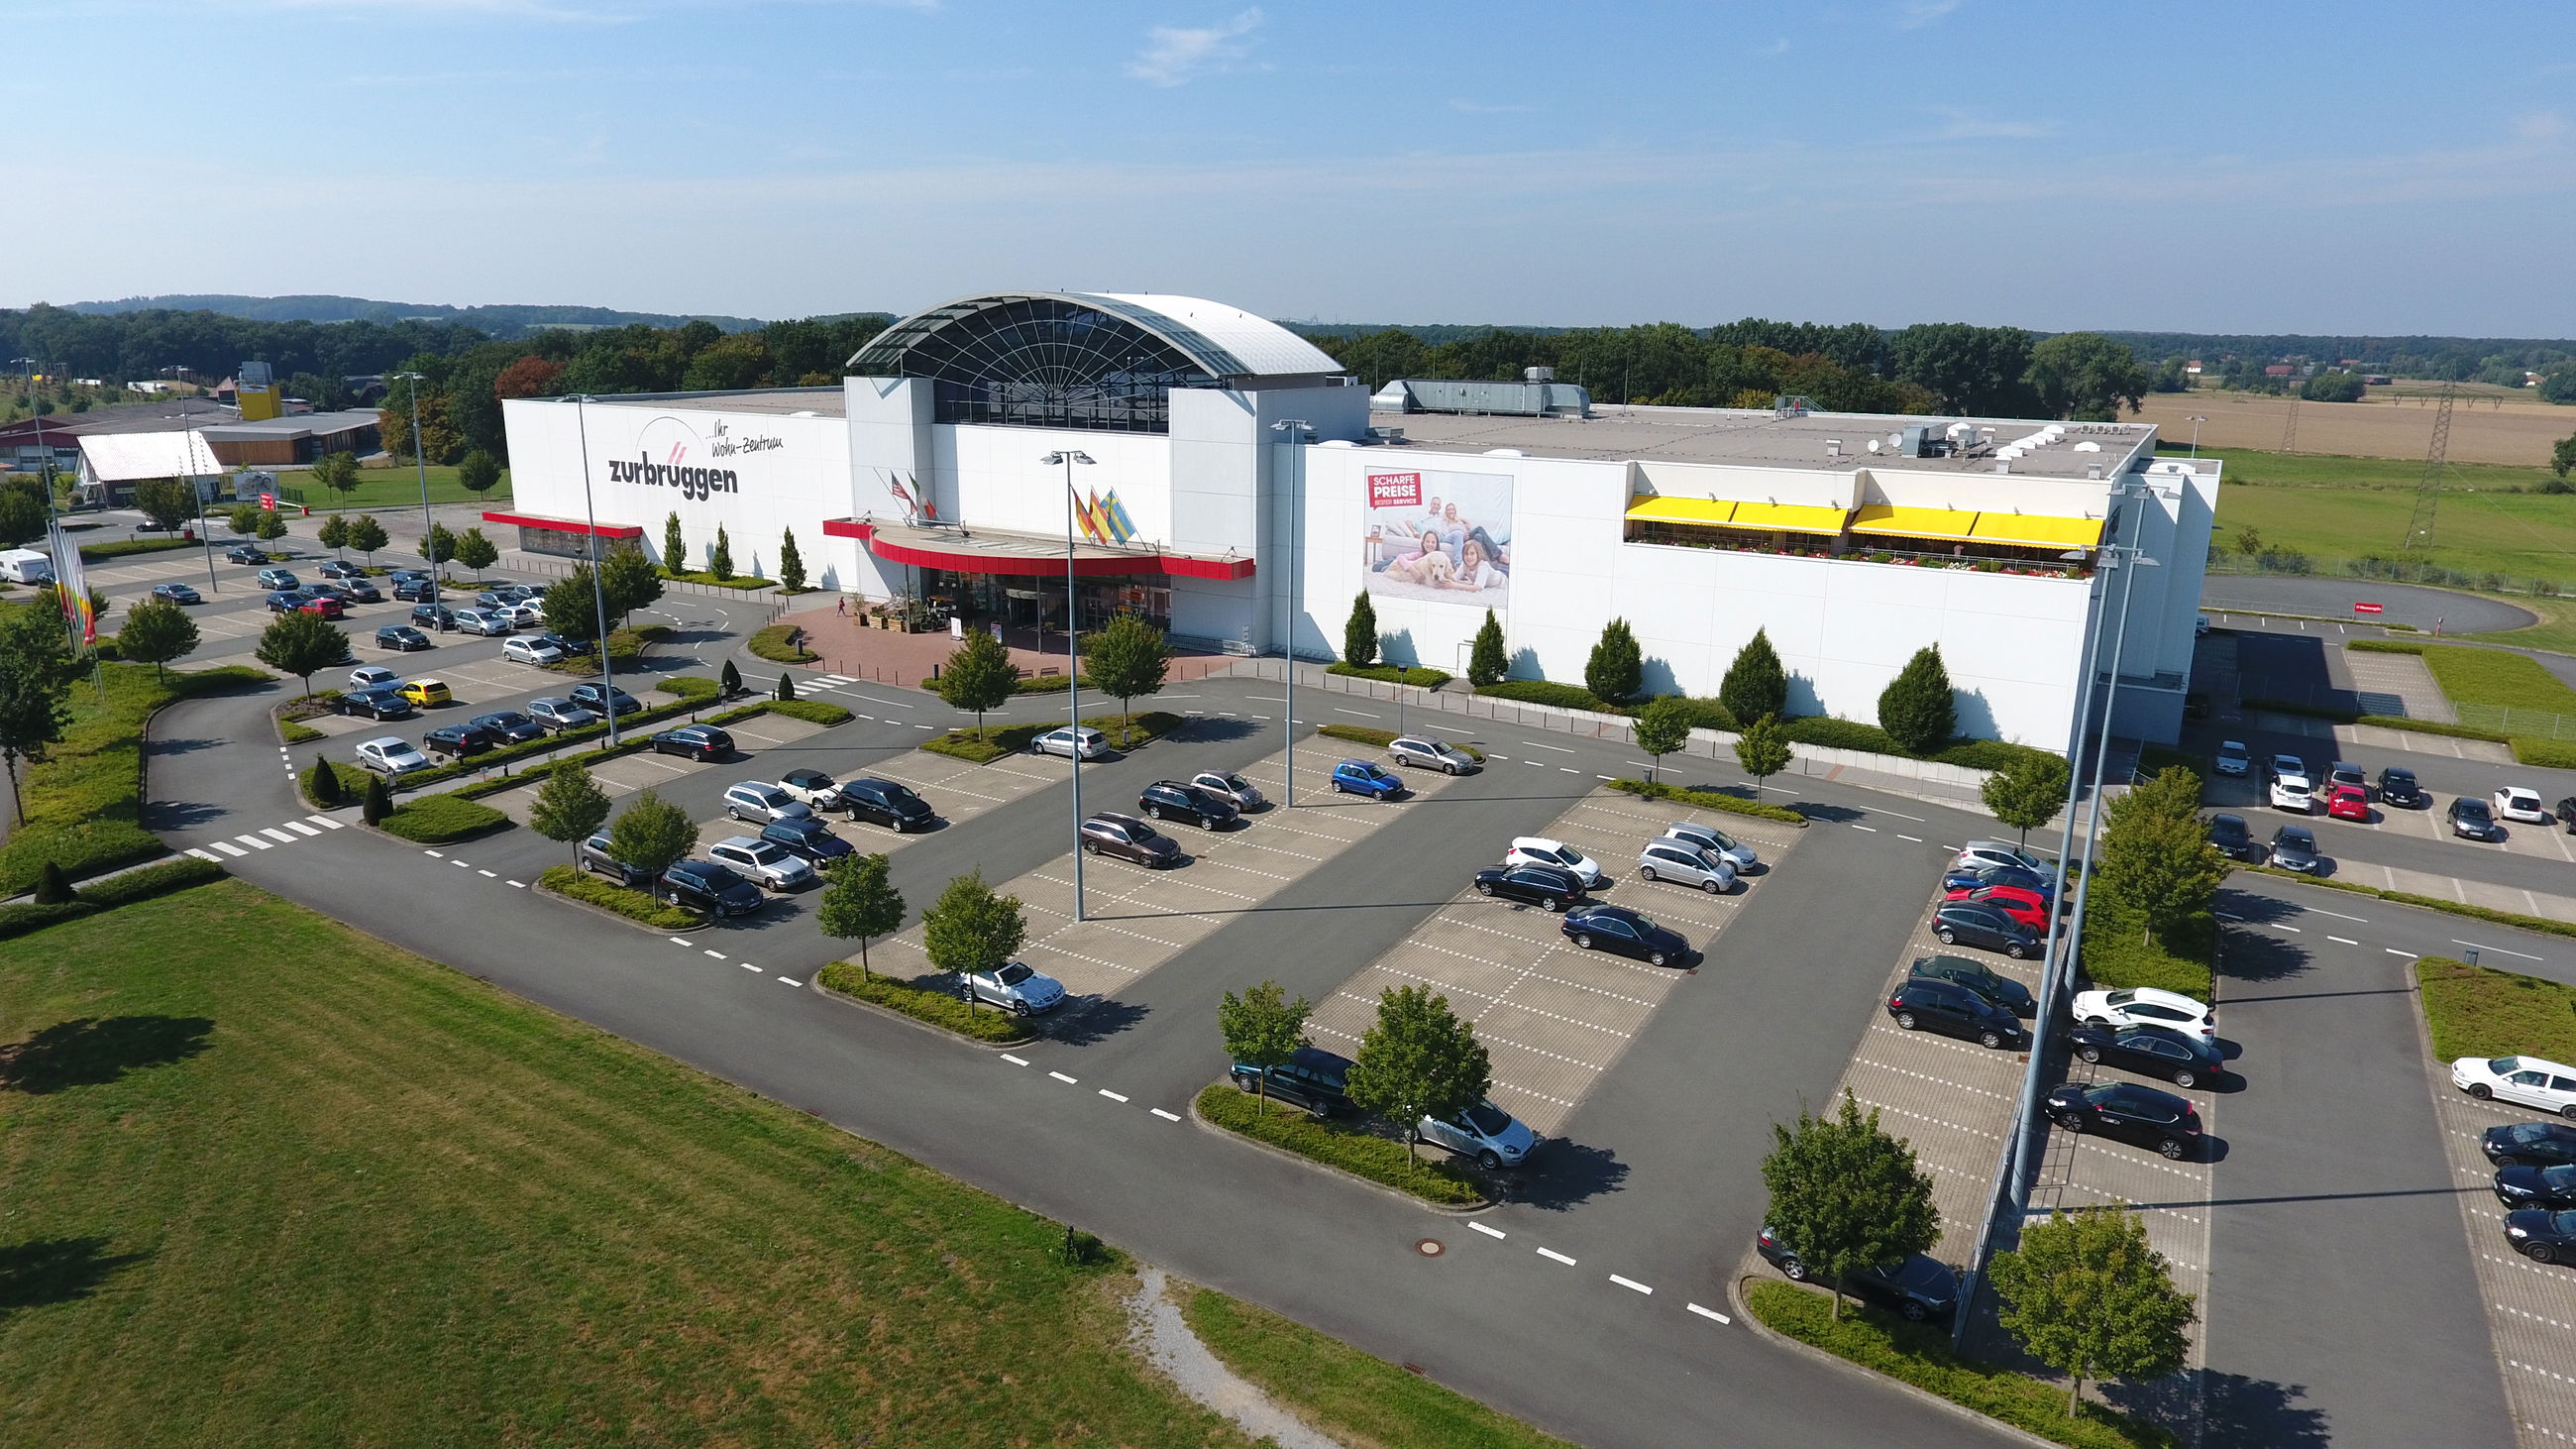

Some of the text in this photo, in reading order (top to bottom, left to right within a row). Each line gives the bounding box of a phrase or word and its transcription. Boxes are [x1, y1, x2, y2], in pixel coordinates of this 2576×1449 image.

[608, 441, 738, 502] zurbrüggen
[1373, 475, 1415, 486] SCHARFE
[1373, 485, 1416, 498] PREISE
